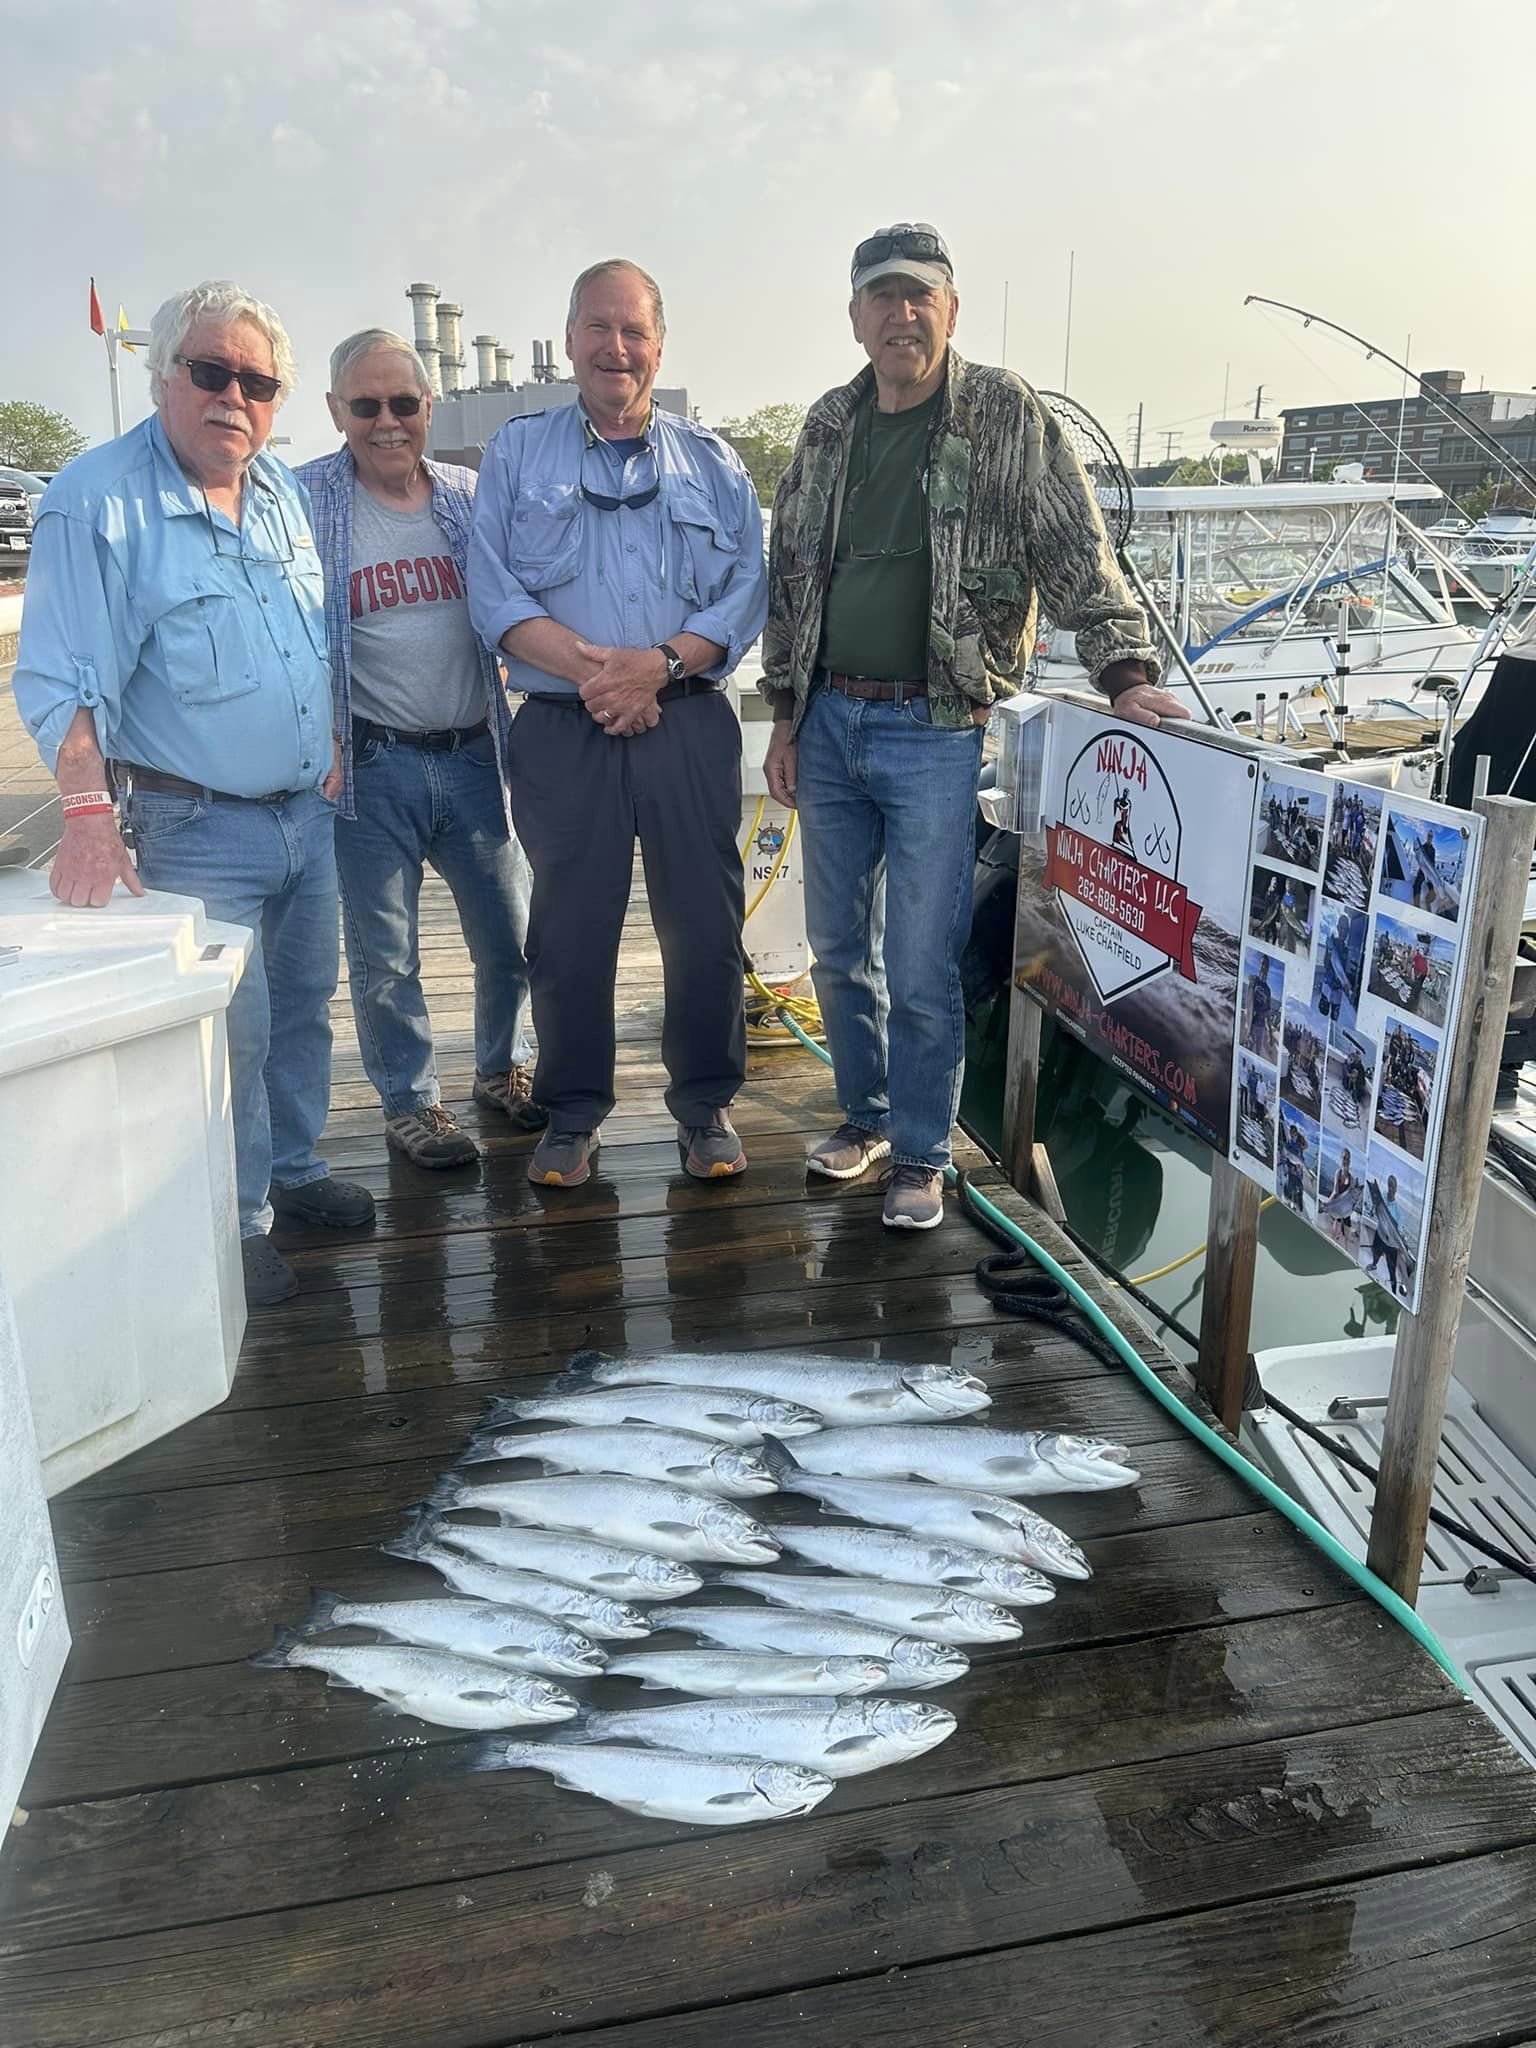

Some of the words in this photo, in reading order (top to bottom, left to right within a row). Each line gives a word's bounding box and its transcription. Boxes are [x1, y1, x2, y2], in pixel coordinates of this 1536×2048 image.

[1096, 739, 1148, 792] NINJA
[1056, 830, 1084, 869] NINJA
[1088, 847, 1149, 905] CHARTERS
[1154, 880, 1180, 924] LLC
[1077, 876, 1146, 932] 262-689-5630
[1094, 916, 1123, 942] CAPTAIN
[1076, 918, 1096, 941] LUKE
[1096, 931, 1142, 970] CHATFIELD
